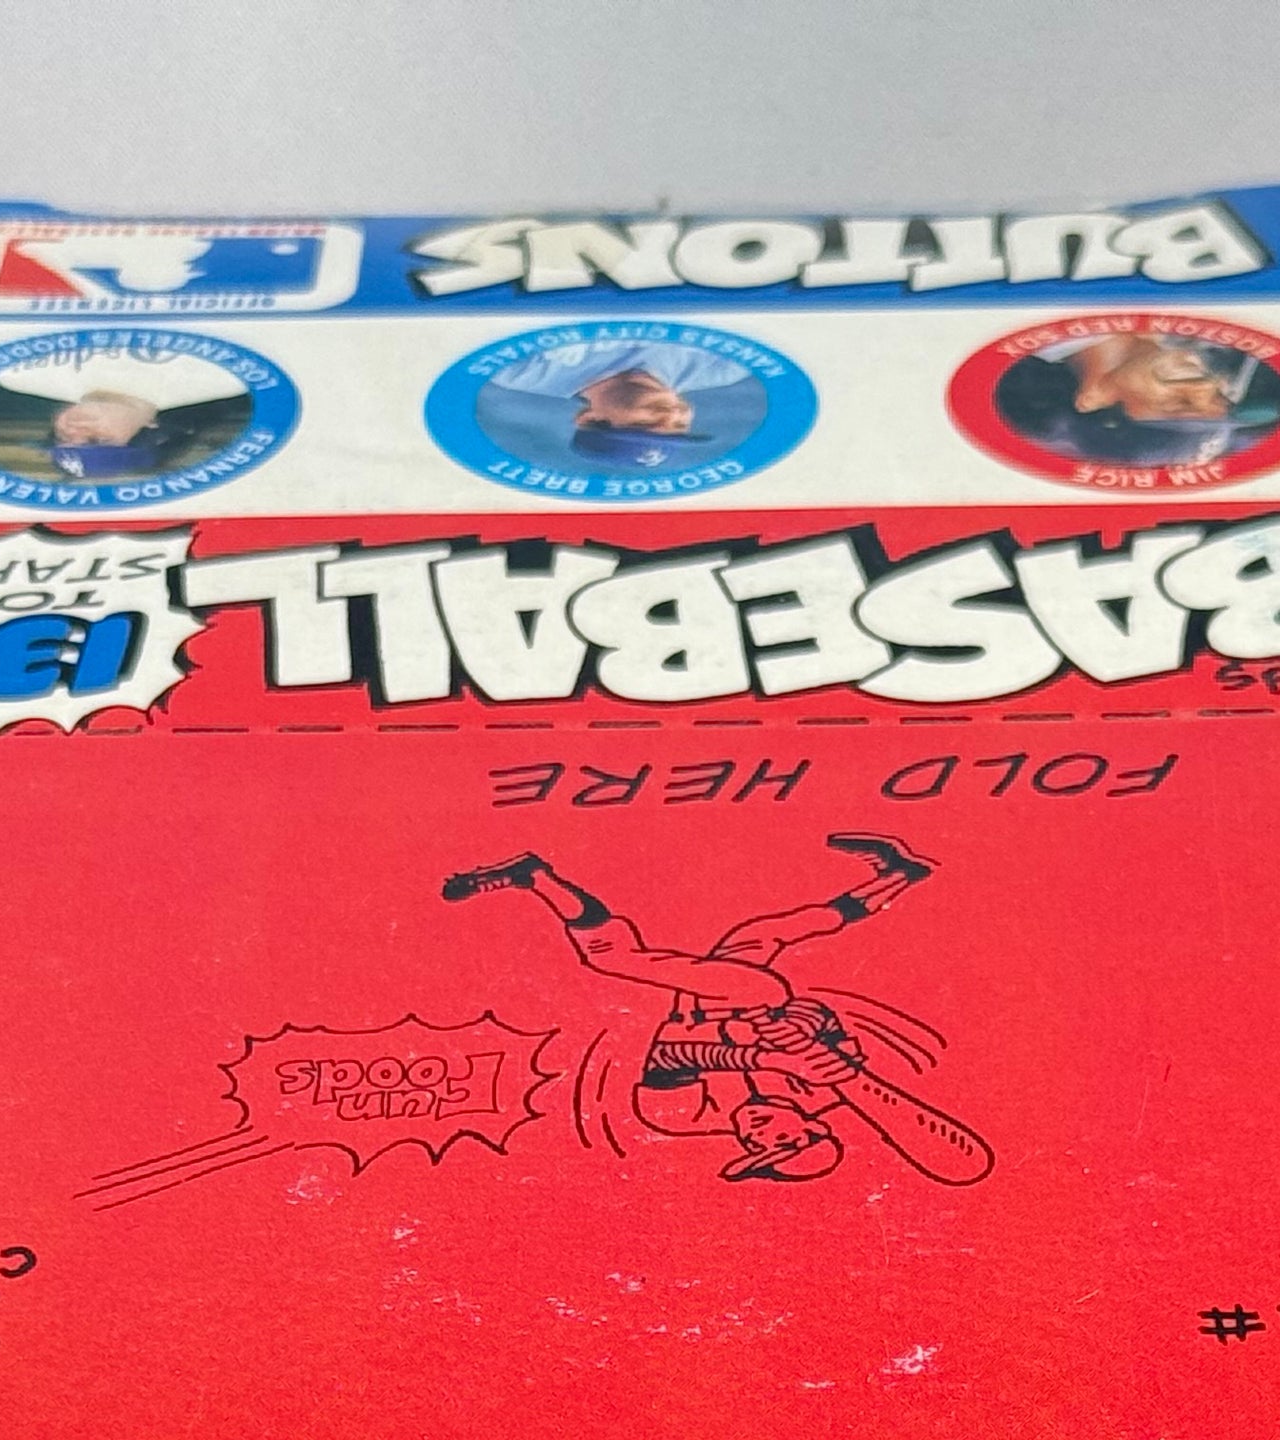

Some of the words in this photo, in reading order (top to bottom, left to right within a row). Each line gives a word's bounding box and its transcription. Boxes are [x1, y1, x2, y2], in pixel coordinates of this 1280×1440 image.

[409, 203, 1270, 297] BUTTONS
[600, 325, 668, 341] CITY
[996, 330, 1061, 358] SOX
[1065, 317, 1136, 337] RED
[1149, 318, 1280, 358] BOSTON
[467, 326, 583, 378] ROYALS
[682, 326, 788, 379] KANSAS
[233, 356, 279, 391] LOS
[112, 430, 276, 502] FERNANDO
[486, 460, 586, 496] BRETT
[602, 460, 747, 497] GEORGE
[1071, 464, 1156, 489] RICE
[1170, 464, 1227, 487] JIM
[488, 758, 812, 807] HERE
[880, 752, 1179, 800] FOLD
[1197, 1303, 1266, 1346] #
